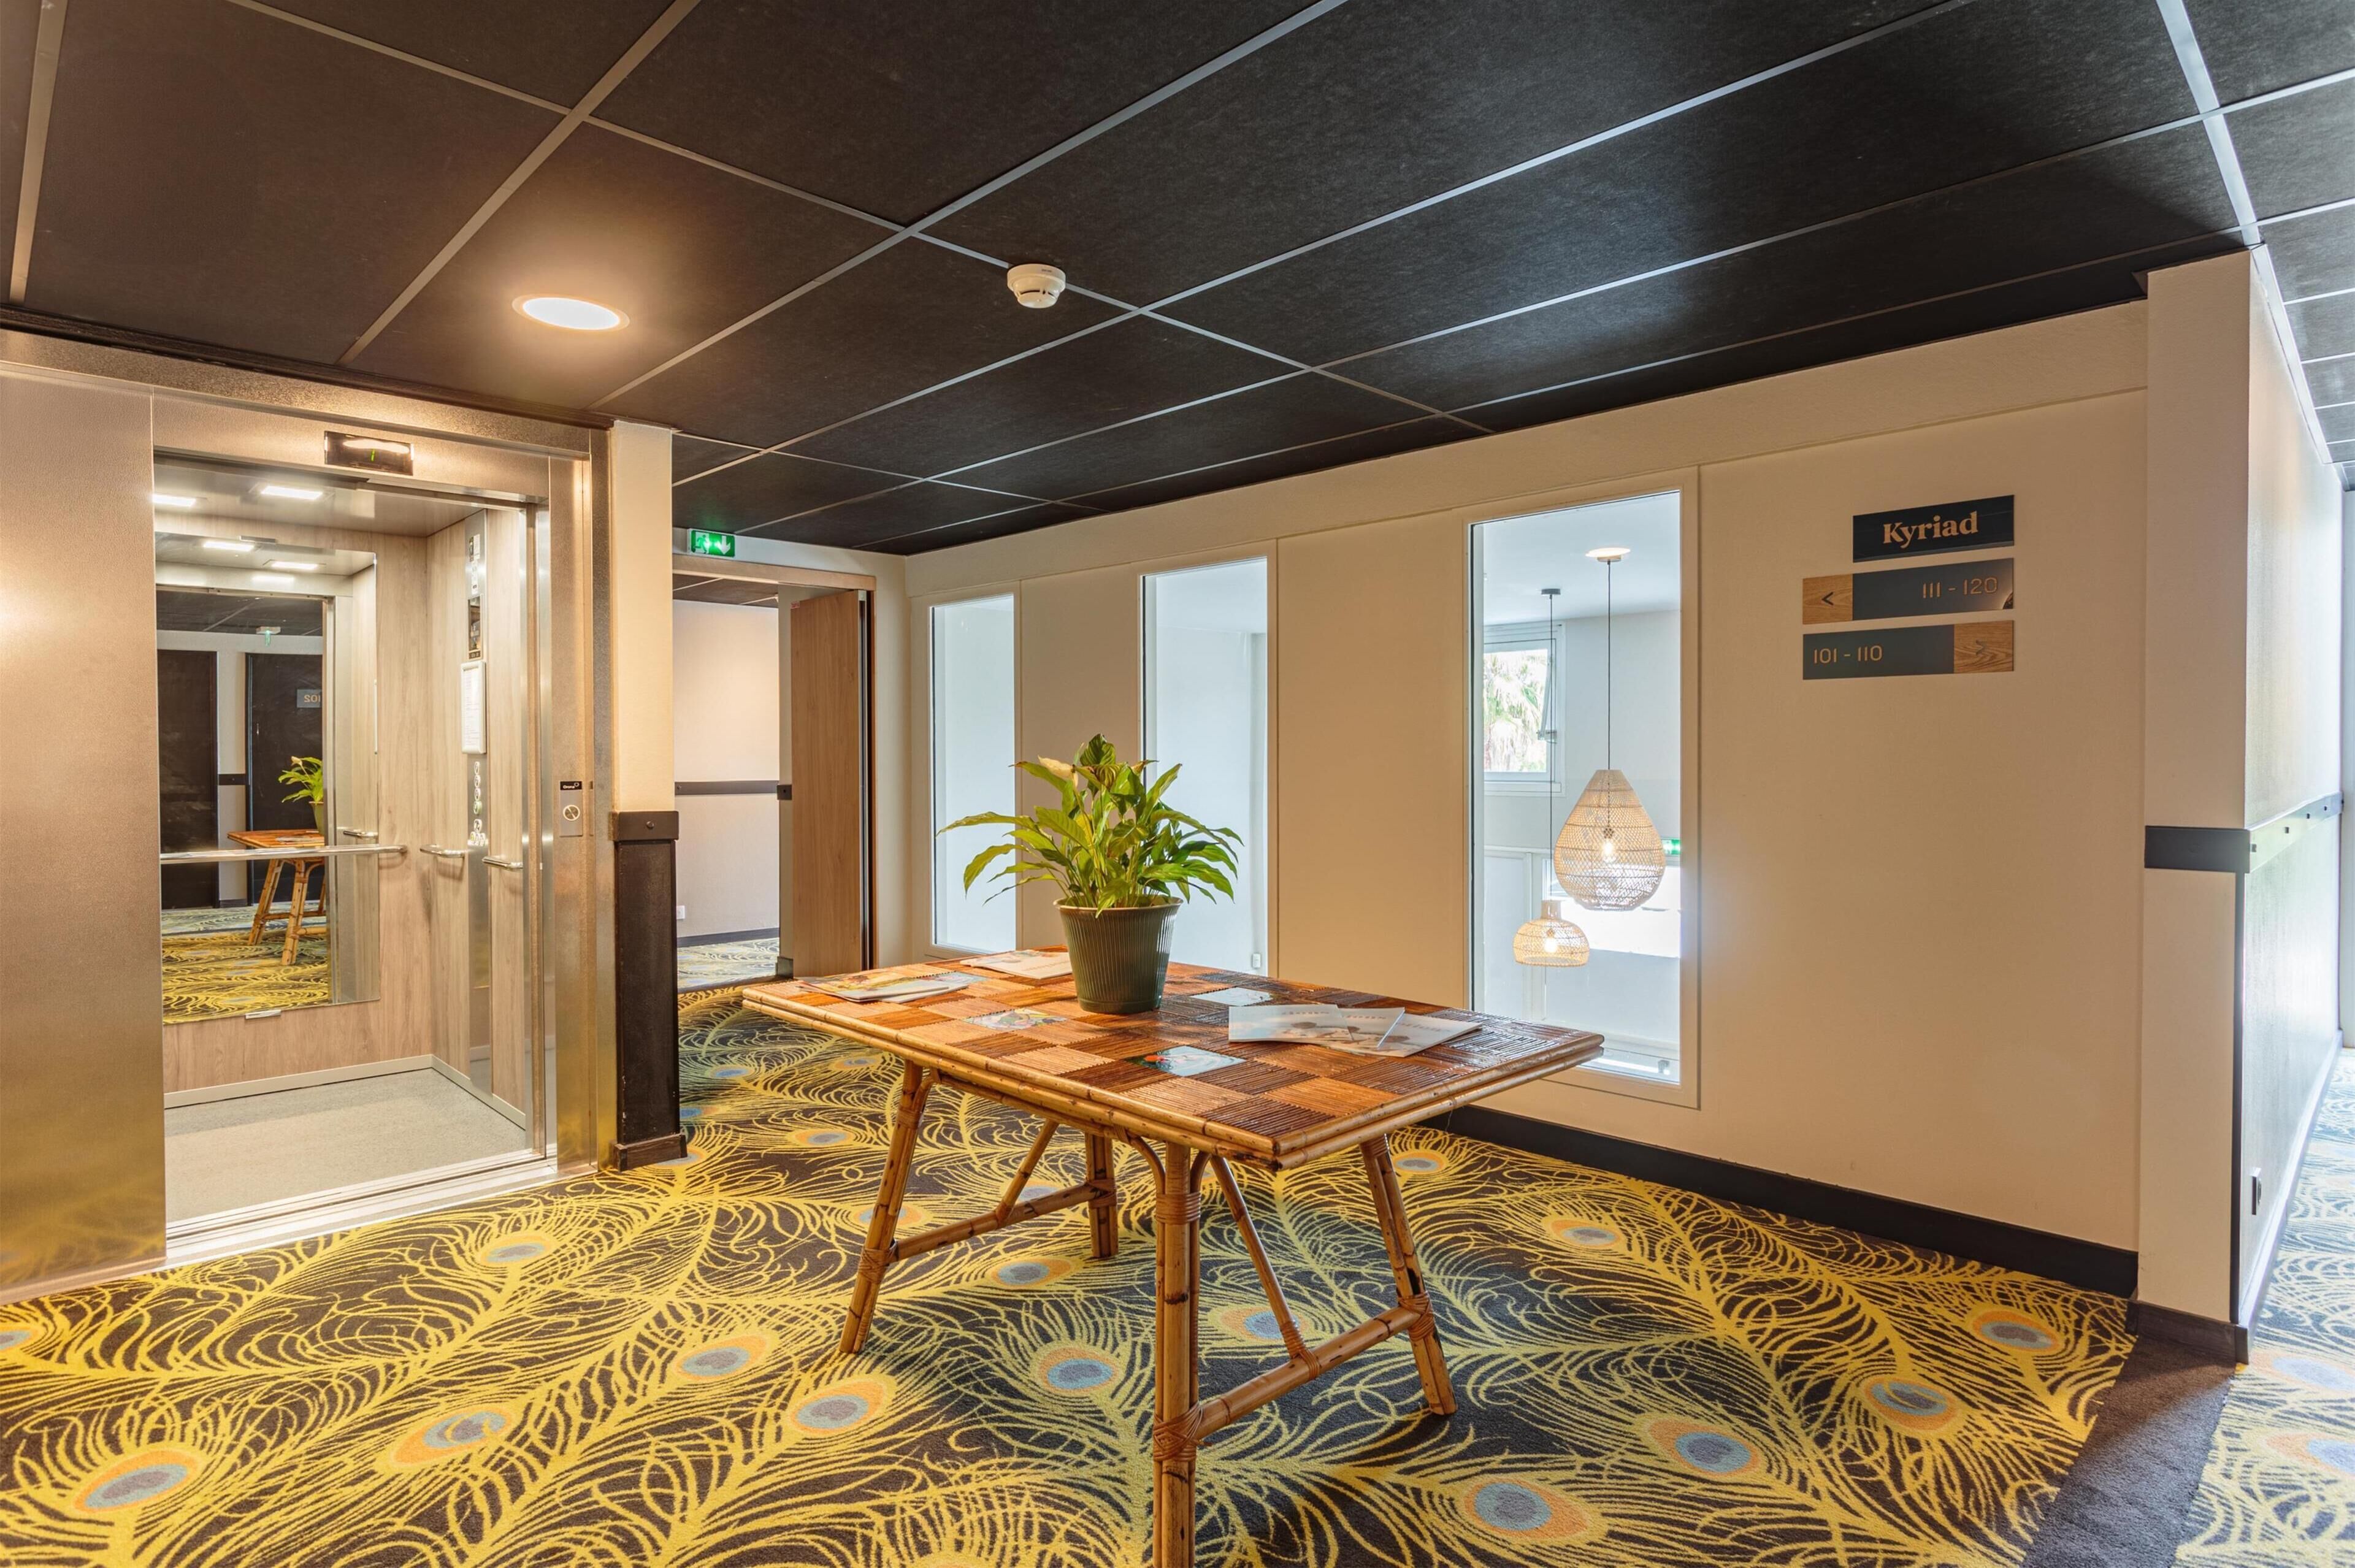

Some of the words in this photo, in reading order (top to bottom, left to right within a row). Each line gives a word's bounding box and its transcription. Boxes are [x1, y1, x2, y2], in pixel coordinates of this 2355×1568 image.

[1883, 510, 1978, 548] Kyriad
[1923, 581, 1942, 599] 111
[1963, 577, 1997, 595] 120
[1814, 648, 1837, 664] 101
[1857, 645, 1883, 662] 110
